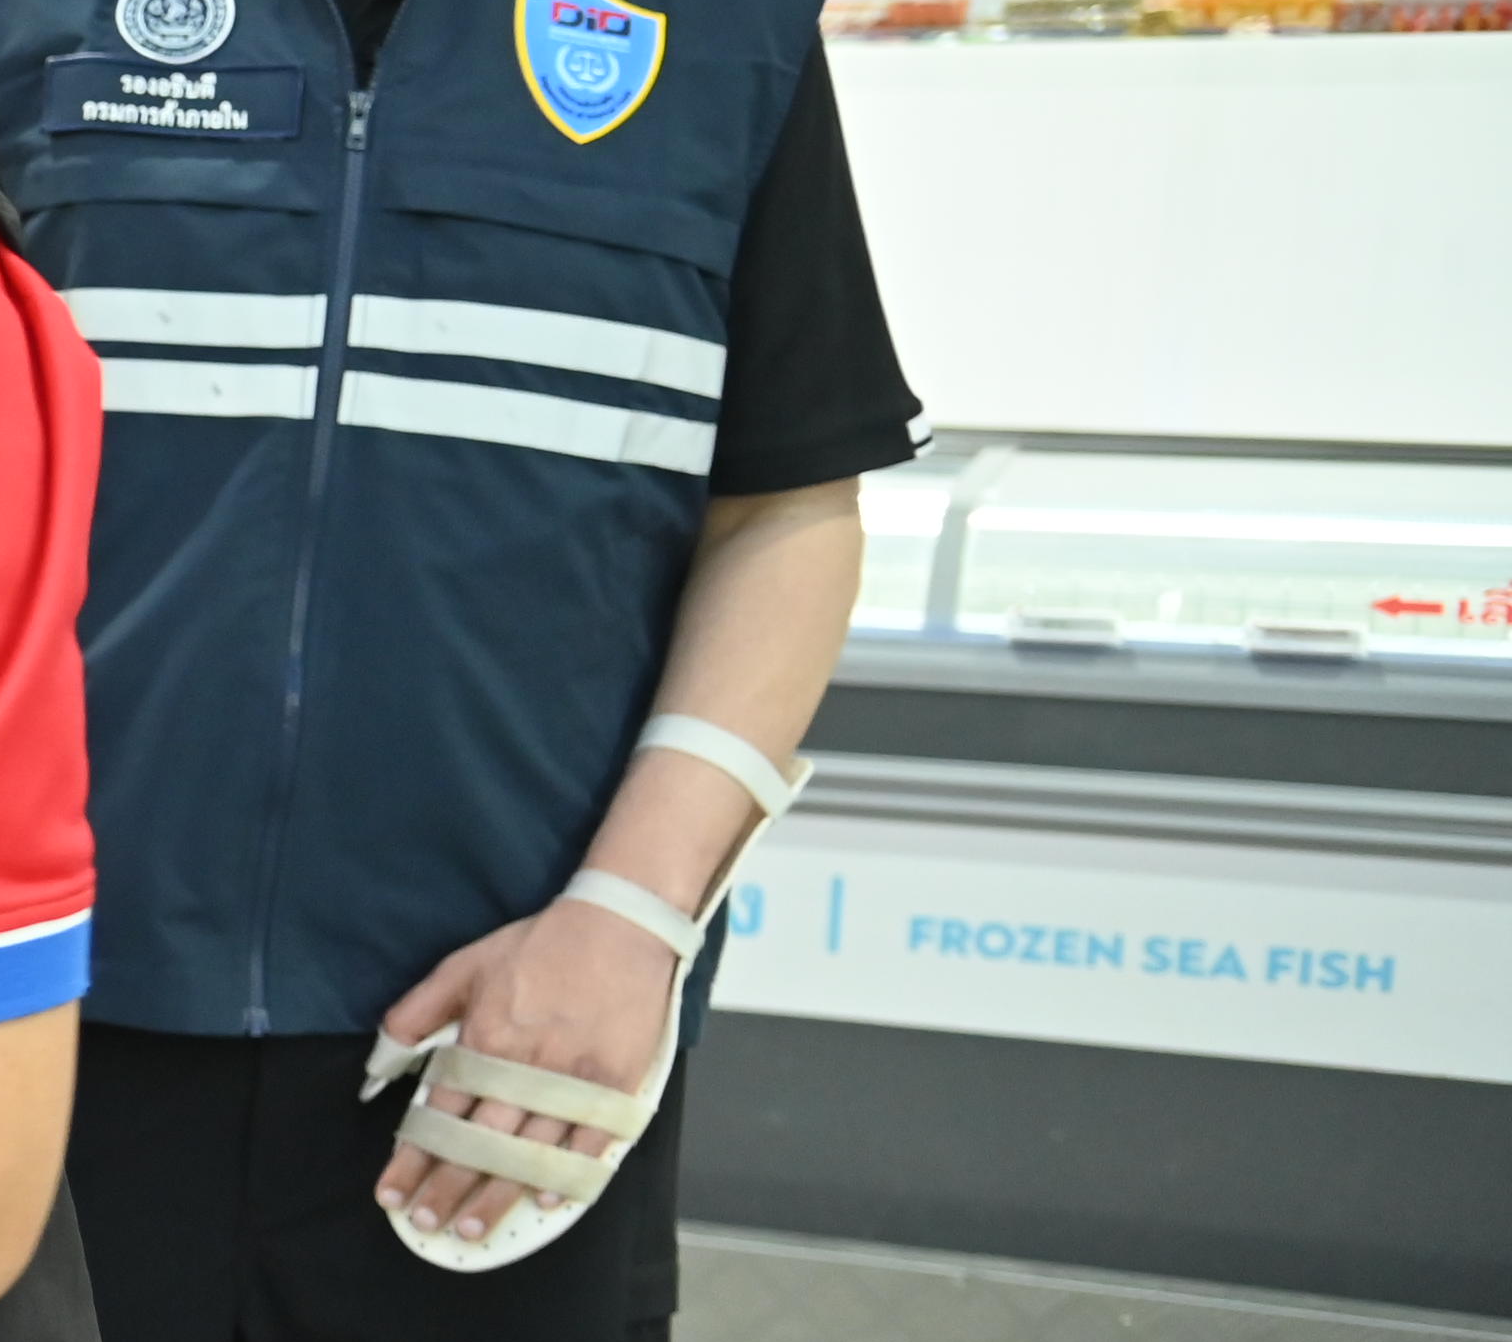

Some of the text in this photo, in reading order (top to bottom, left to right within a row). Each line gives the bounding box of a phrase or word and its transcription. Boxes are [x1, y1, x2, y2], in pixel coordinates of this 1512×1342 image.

[908, 914, 1396, 994] FROZEN SEA FISH
